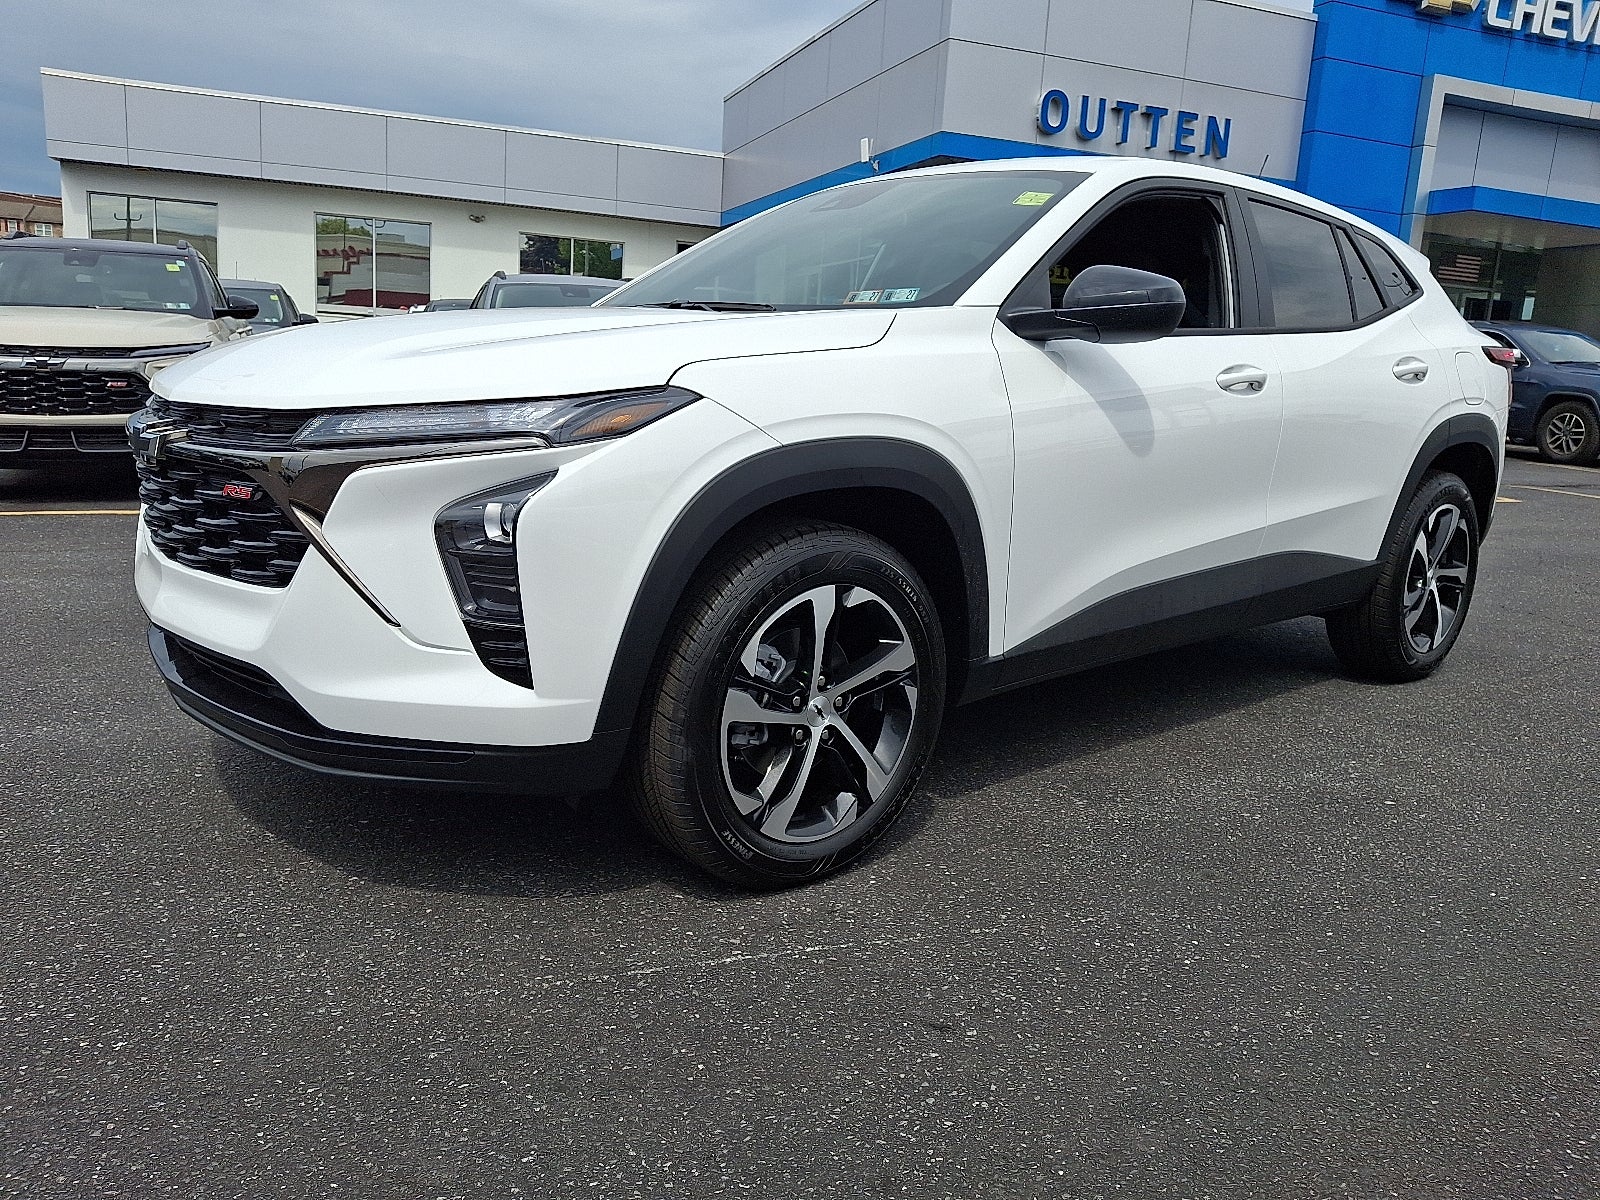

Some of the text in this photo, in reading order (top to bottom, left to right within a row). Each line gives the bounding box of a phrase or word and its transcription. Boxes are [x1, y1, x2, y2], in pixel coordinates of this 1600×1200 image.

[1038, 88, 1232, 159] OUTTEN
[906, 289, 917, 300] 27
[222, 484, 253, 499] RS
